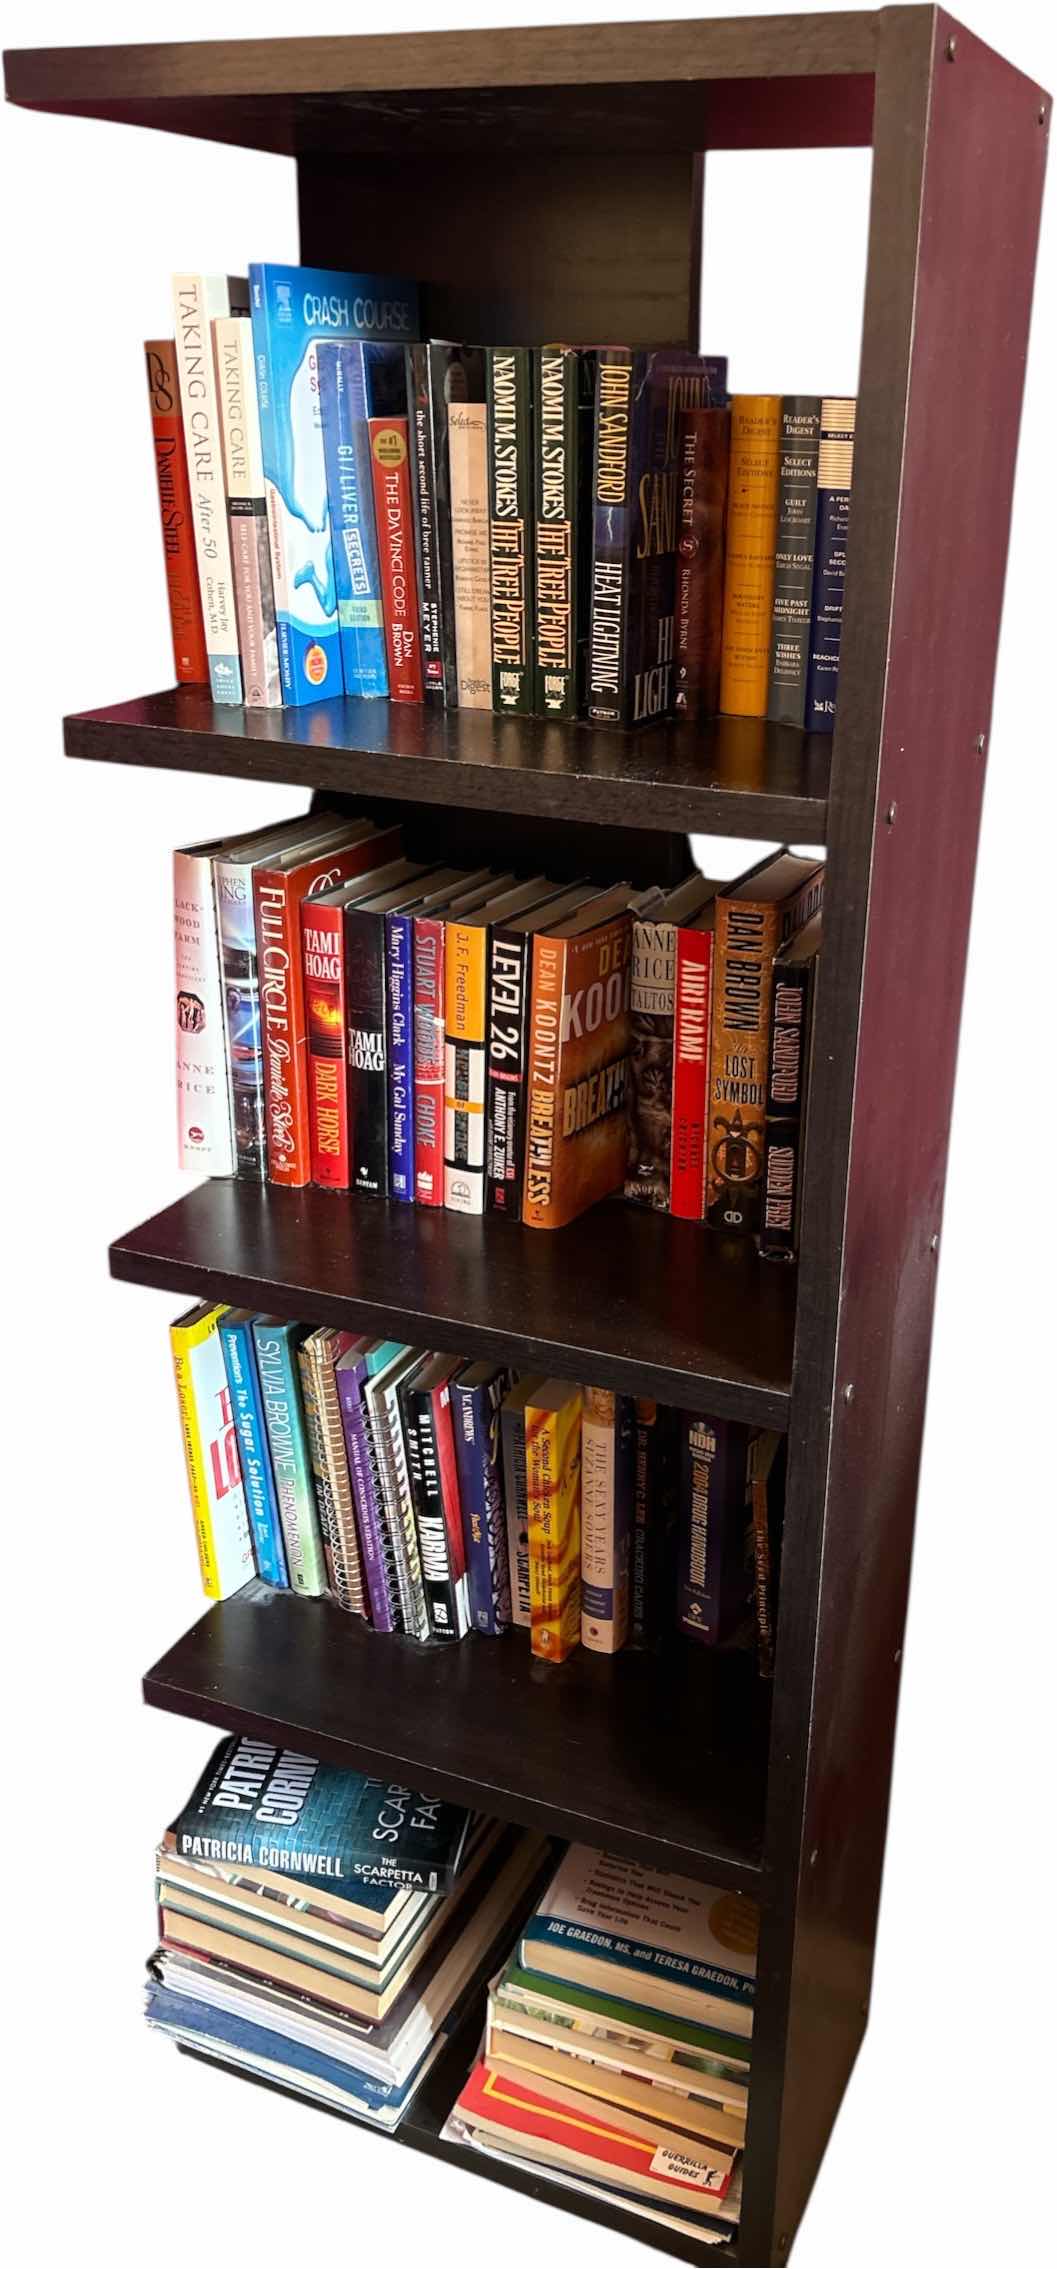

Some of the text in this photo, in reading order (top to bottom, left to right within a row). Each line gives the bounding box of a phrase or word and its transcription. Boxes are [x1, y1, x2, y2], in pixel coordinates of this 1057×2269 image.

[303, 293, 349, 328] CRASH
[353, 296, 410, 331] COURSE
[178, 283, 214, 482] TAKING CARE
[223, 339, 242, 420] TAKING
[493, 356, 518, 518] NAOMI M. STOKES
[541, 356, 566, 519] NAOMI M. STOKES
[597, 364, 632, 503] JOHN SANDFORD
[783, 414, 820, 425] READER'S
[786, 425, 814, 435] DIGEST
[229, 427, 246, 480] CARE
[781, 467, 817, 477] EDITIONS
[784, 457, 812, 467] SELECT
[337, 446, 359, 524] GI/LIVER
[385, 472, 399, 504] THE
[416, 410, 431, 589] the short second life of bree tanner
[682, 432, 697, 526] THE SECRET
[785, 499, 807, 507] GUILT
[198, 493, 218, 559] After 50
[386, 509, 401, 530] DA
[345, 532, 368, 593] SECRETS
[389, 531, 404, 577] VINCI
[793, 554, 814, 562] LOVE
[217, 582, 229, 633] Harvey Jay
[242, 567, 256, 647] FOR YOU AND YOUR
[391, 576, 408, 617] CODE
[491, 518, 526, 665] THE TREE PEOPLE
[536, 520, 572, 668] THE TREE PEOPLE
[592, 561, 622, 606] HEAT
[790, 599, 809, 608] PAST
[423, 602, 432, 653] MEYER
[430, 602, 440, 652] STEPHENIE
[679, 569, 691, 649] RHONDA BYRNE
[391, 623, 404, 667] BROWN
[402, 631, 414, 657] DAN
[590, 609, 621, 694] LIGHTNING
[258, 886, 290, 1031] FULL CIRCLE
[304, 928, 341, 955] TAMI
[633, 926, 675, 954] ANNE
[304, 953, 342, 980] HOAG
[388, 926, 406, 1046] Mary Higgins Clark
[456, 933, 469, 1031] J. F. Freedman
[491, 940, 521, 1017] LEVEL
[632, 956, 674, 980] RICE
[724, 912, 764, 1032] DAN BROWN
[415, 936, 436, 1064] STUART WOODS
[533, 948, 557, 1085] DEAN KOONTZ
[631, 988, 673, 1012] TALTOS
[679, 960, 706, 1063] AIRFRAME
[349, 1028, 383, 1051] TAMI
[349, 1047, 385, 1071] HOAG
[490, 1023, 520, 1060] 26
[772, 982, 803, 1103] JOHN SANDFORD
[177, 1081, 216, 1095] RICE
[724, 1055, 756, 1079] LOST
[267, 1034, 295, 1153] Danielle Steel
[315, 1062, 340, 1156] DARK HORSE
[390, 1064, 407, 1157] My Gal Sunday
[494, 1087, 507, 1134] ANTHONY
[715, 1079, 765, 1105] SYMBOL
[416, 1095, 436, 1148] CHOKE
[493, 1143, 506, 1181] ZUIKER
[527, 1089, 554, 1207] BREATHLESS
[765, 1146, 795, 1230] SUDDEN PREY
[175, 1356, 185, 1371] Be
[237, 1389, 249, 1408] The
[257, 1339, 297, 1474] SYLVIA BROWNE
[240, 1413, 256, 1453] Sugar
[462, 1405, 475, 1443] ANDREWS
[350, 1433, 370, 1522] MANUAL OF CONSCIOUS
[407, 1429, 422, 1481] SMITH
[418, 1414, 439, 1497] MITCHELL
[541, 1438, 552, 1470] Second
[595, 1442, 607, 1472] THE
[692, 1461, 710, 1492] 2004
[246, 1458, 267, 1517] Solution
[530, 1459, 541, 1522] Woman's Soul
[541, 1473, 552, 1510] Chicken
[582, 1439, 596, 1570] SUZANNE SOMERS
[594, 1480, 607, 1520] SEXY
[691, 1492, 708, 1525] DRUG
[278, 1478, 304, 1568] PHENOMENON
[542, 1512, 553, 1534] Soup
[635, 1502, 646, 1523] LEE
[417, 1515, 449, 1582] KARMA
[594, 1527, 607, 1575] YEARS
[690, 1525, 707, 1587] HANDBOOK
[372, 1784, 412, 1843] SCAR
[181, 1834, 345, 1878] PATRICIA CORNWELL
[353, 1863, 423, 1884] SCARPETTA
[381, 1857, 398, 1867] THE
[363, 1876, 413, 1890] FACTOR
[547, 1921, 741, 1991] JOE GRAEDON, and TERESA GRAEDON,
[660, 2149, 709, 2170] GUERRILLA
[667, 2163, 701, 2179] GUIDES
